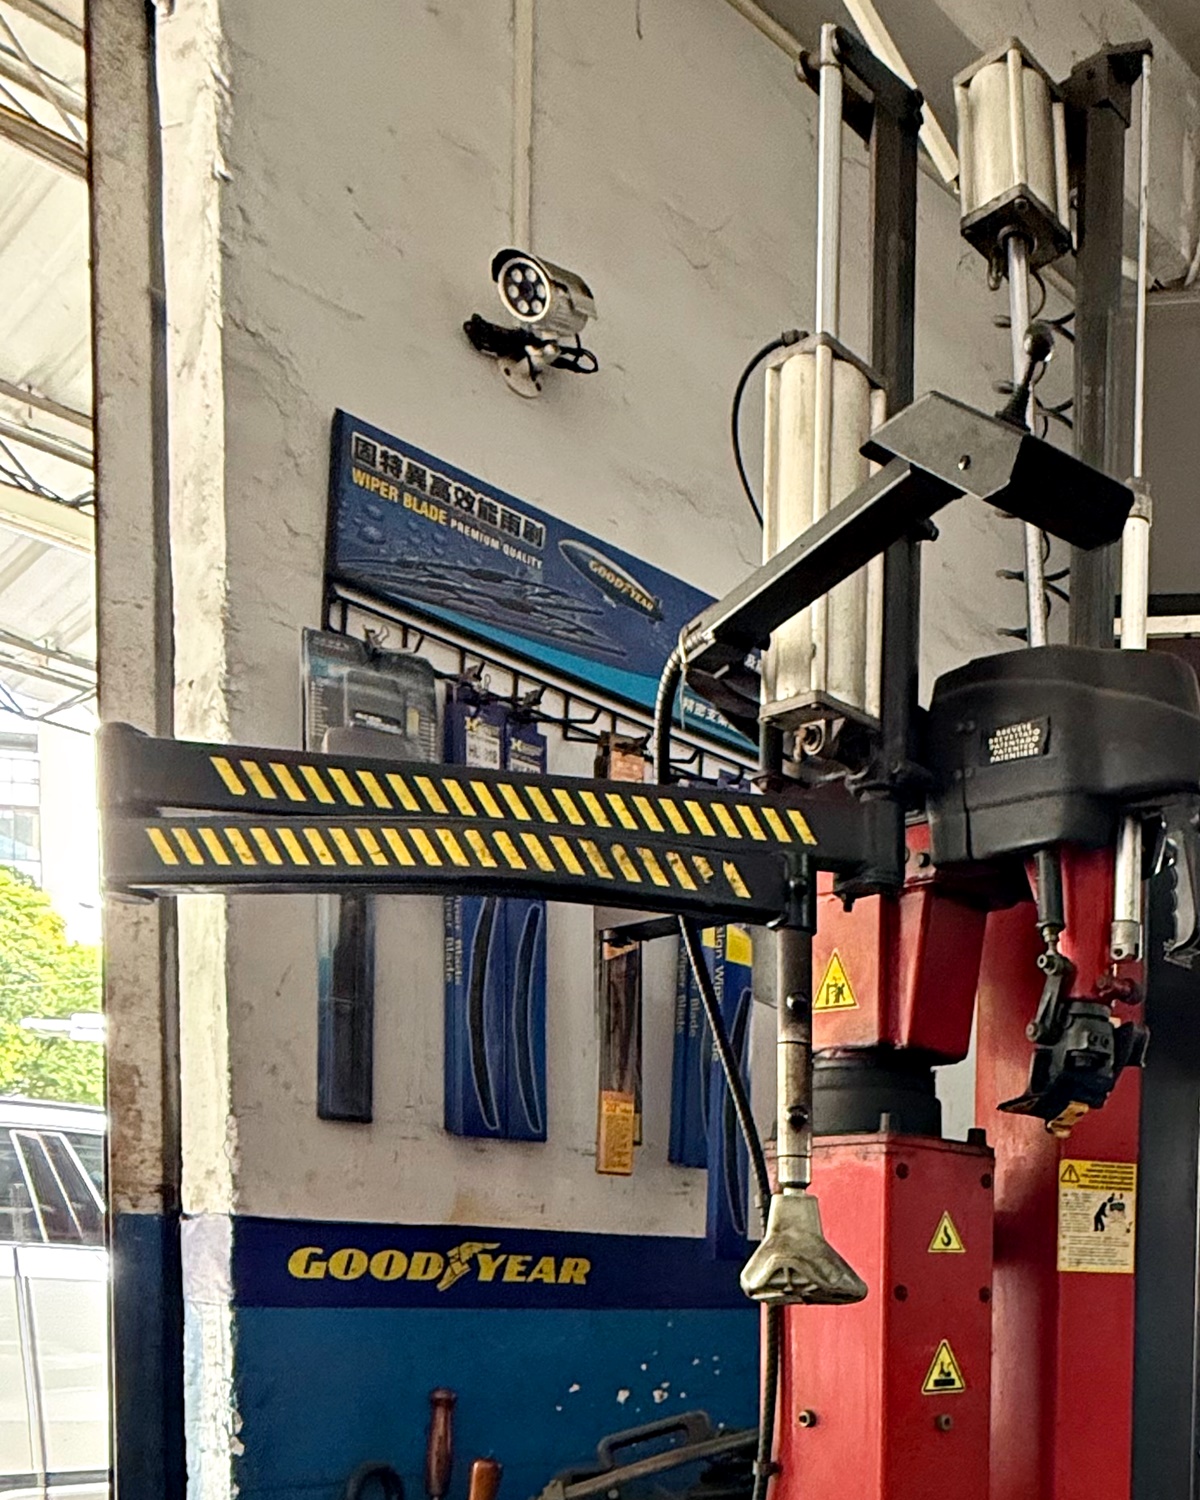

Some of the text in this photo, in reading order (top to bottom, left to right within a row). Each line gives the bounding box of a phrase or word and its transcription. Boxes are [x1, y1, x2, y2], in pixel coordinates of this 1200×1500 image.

[352, 467, 543, 570] WIPER BLADE PREMIUM QUALITY
[353, 432, 546, 549] 固特異高效能雨刷
[588, 559, 655, 612] GOODYEAR
[288, 1246, 592, 1286] GOODYEAR
